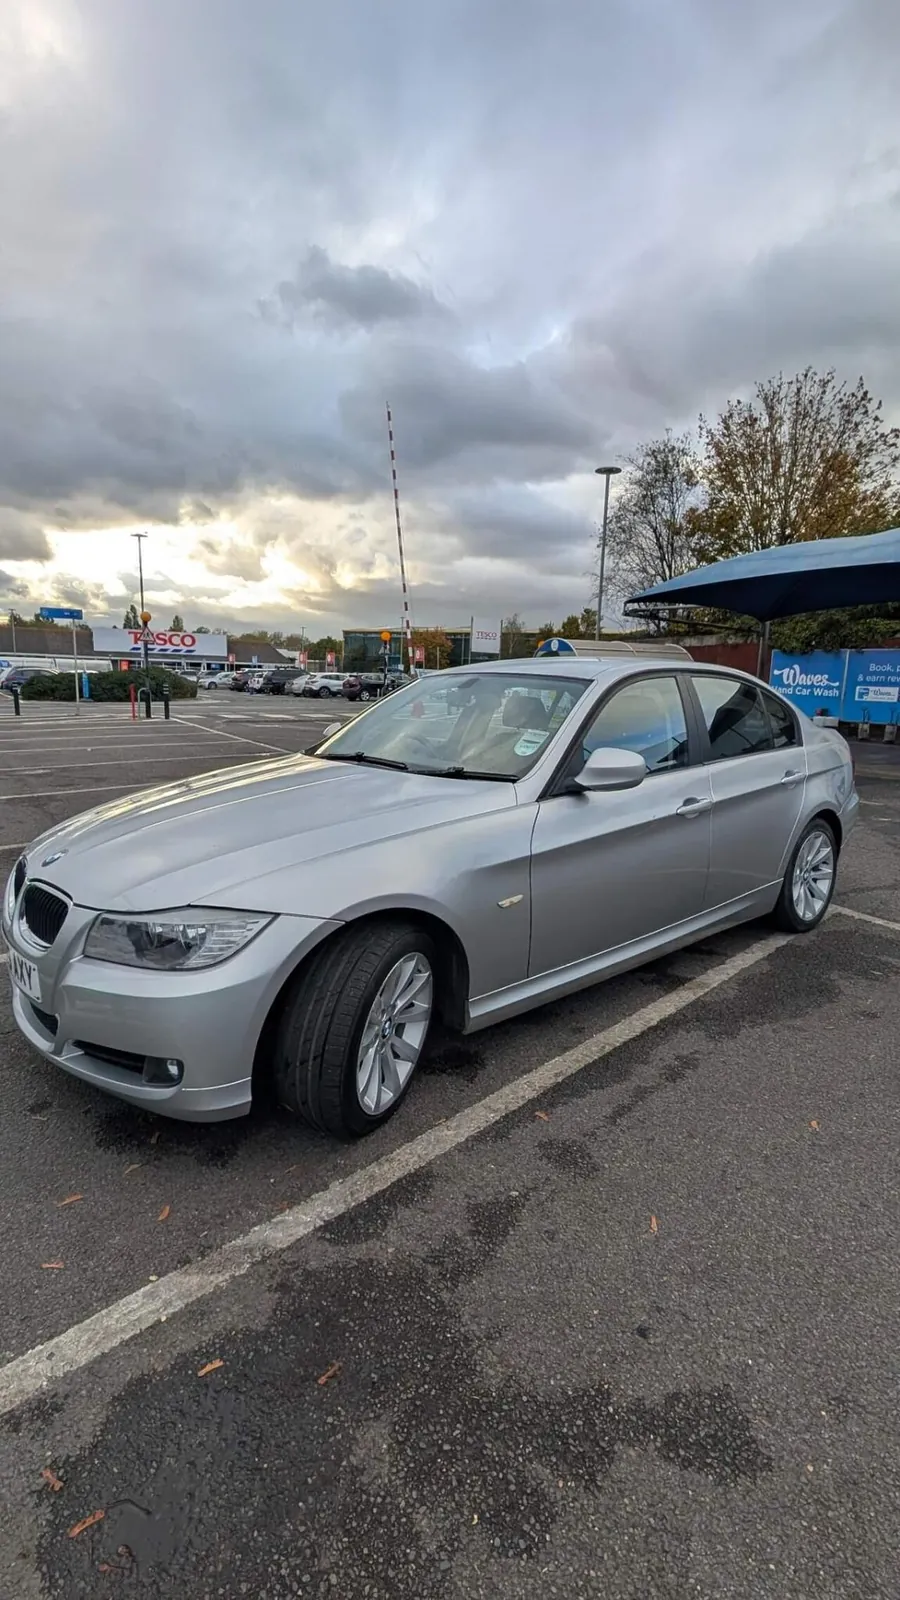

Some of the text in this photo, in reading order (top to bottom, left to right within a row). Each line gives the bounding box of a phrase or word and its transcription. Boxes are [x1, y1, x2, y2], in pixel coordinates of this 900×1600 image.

[773, 664, 840, 687] Waves
[857, 673, 864, 682] &
[866, 675, 885, 683] earn
[795, 686, 811, 696] Car
[813, 687, 839, 697] Wash
